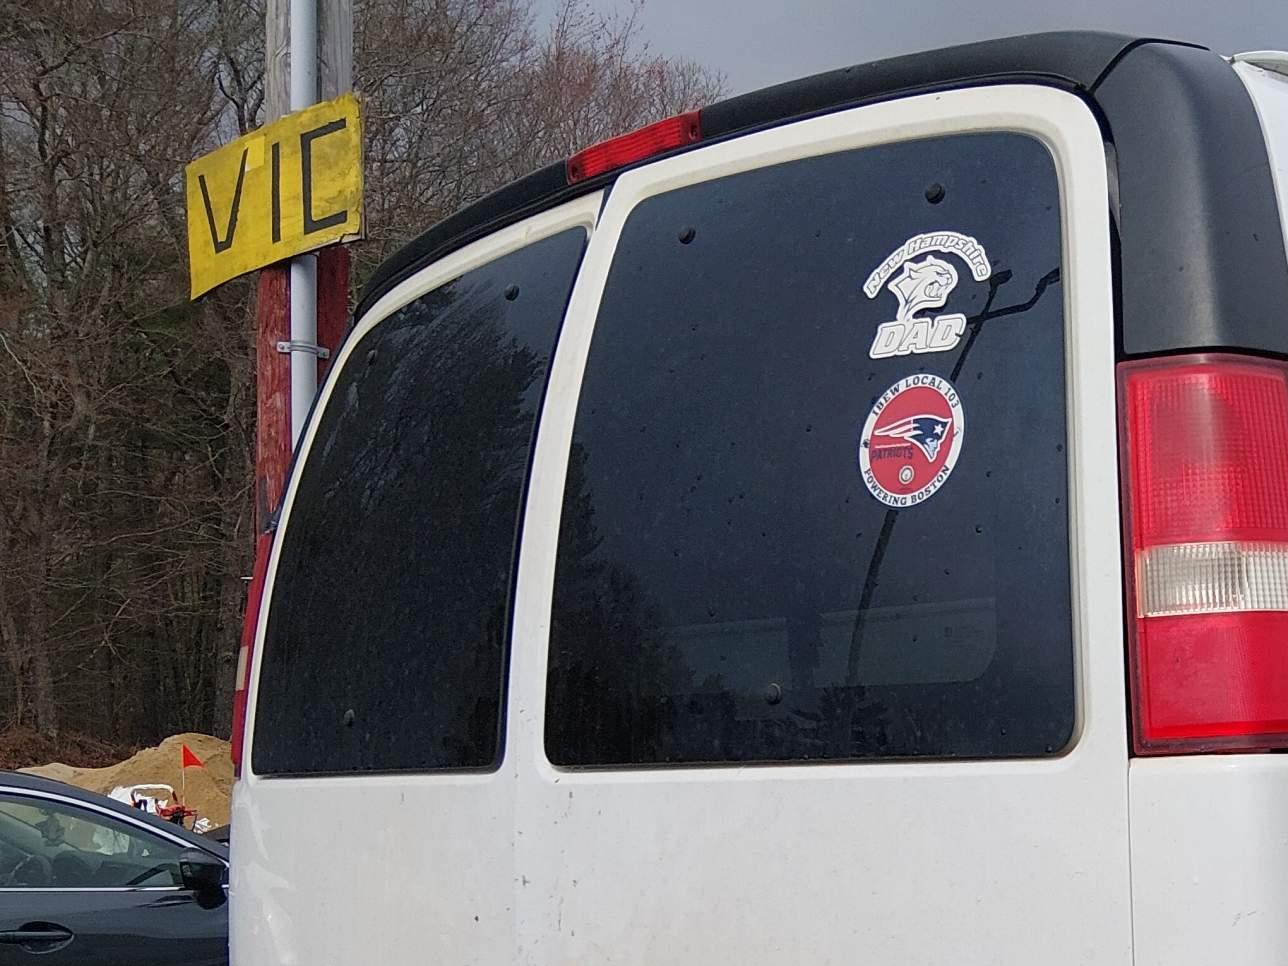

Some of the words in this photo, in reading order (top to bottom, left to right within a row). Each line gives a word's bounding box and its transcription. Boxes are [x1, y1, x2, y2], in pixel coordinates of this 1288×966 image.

[198, 117, 348, 255] VIC
[866, 249, 906, 295] New
[907, 234, 988, 278] Hampshire
[872, 317, 963, 356] DAD
[905, 375, 943, 390] LOCAL
[944, 387, 960, 409] 103
[864, 467, 907, 506] POWERING
[911, 464, 951, 503] BOSTON
